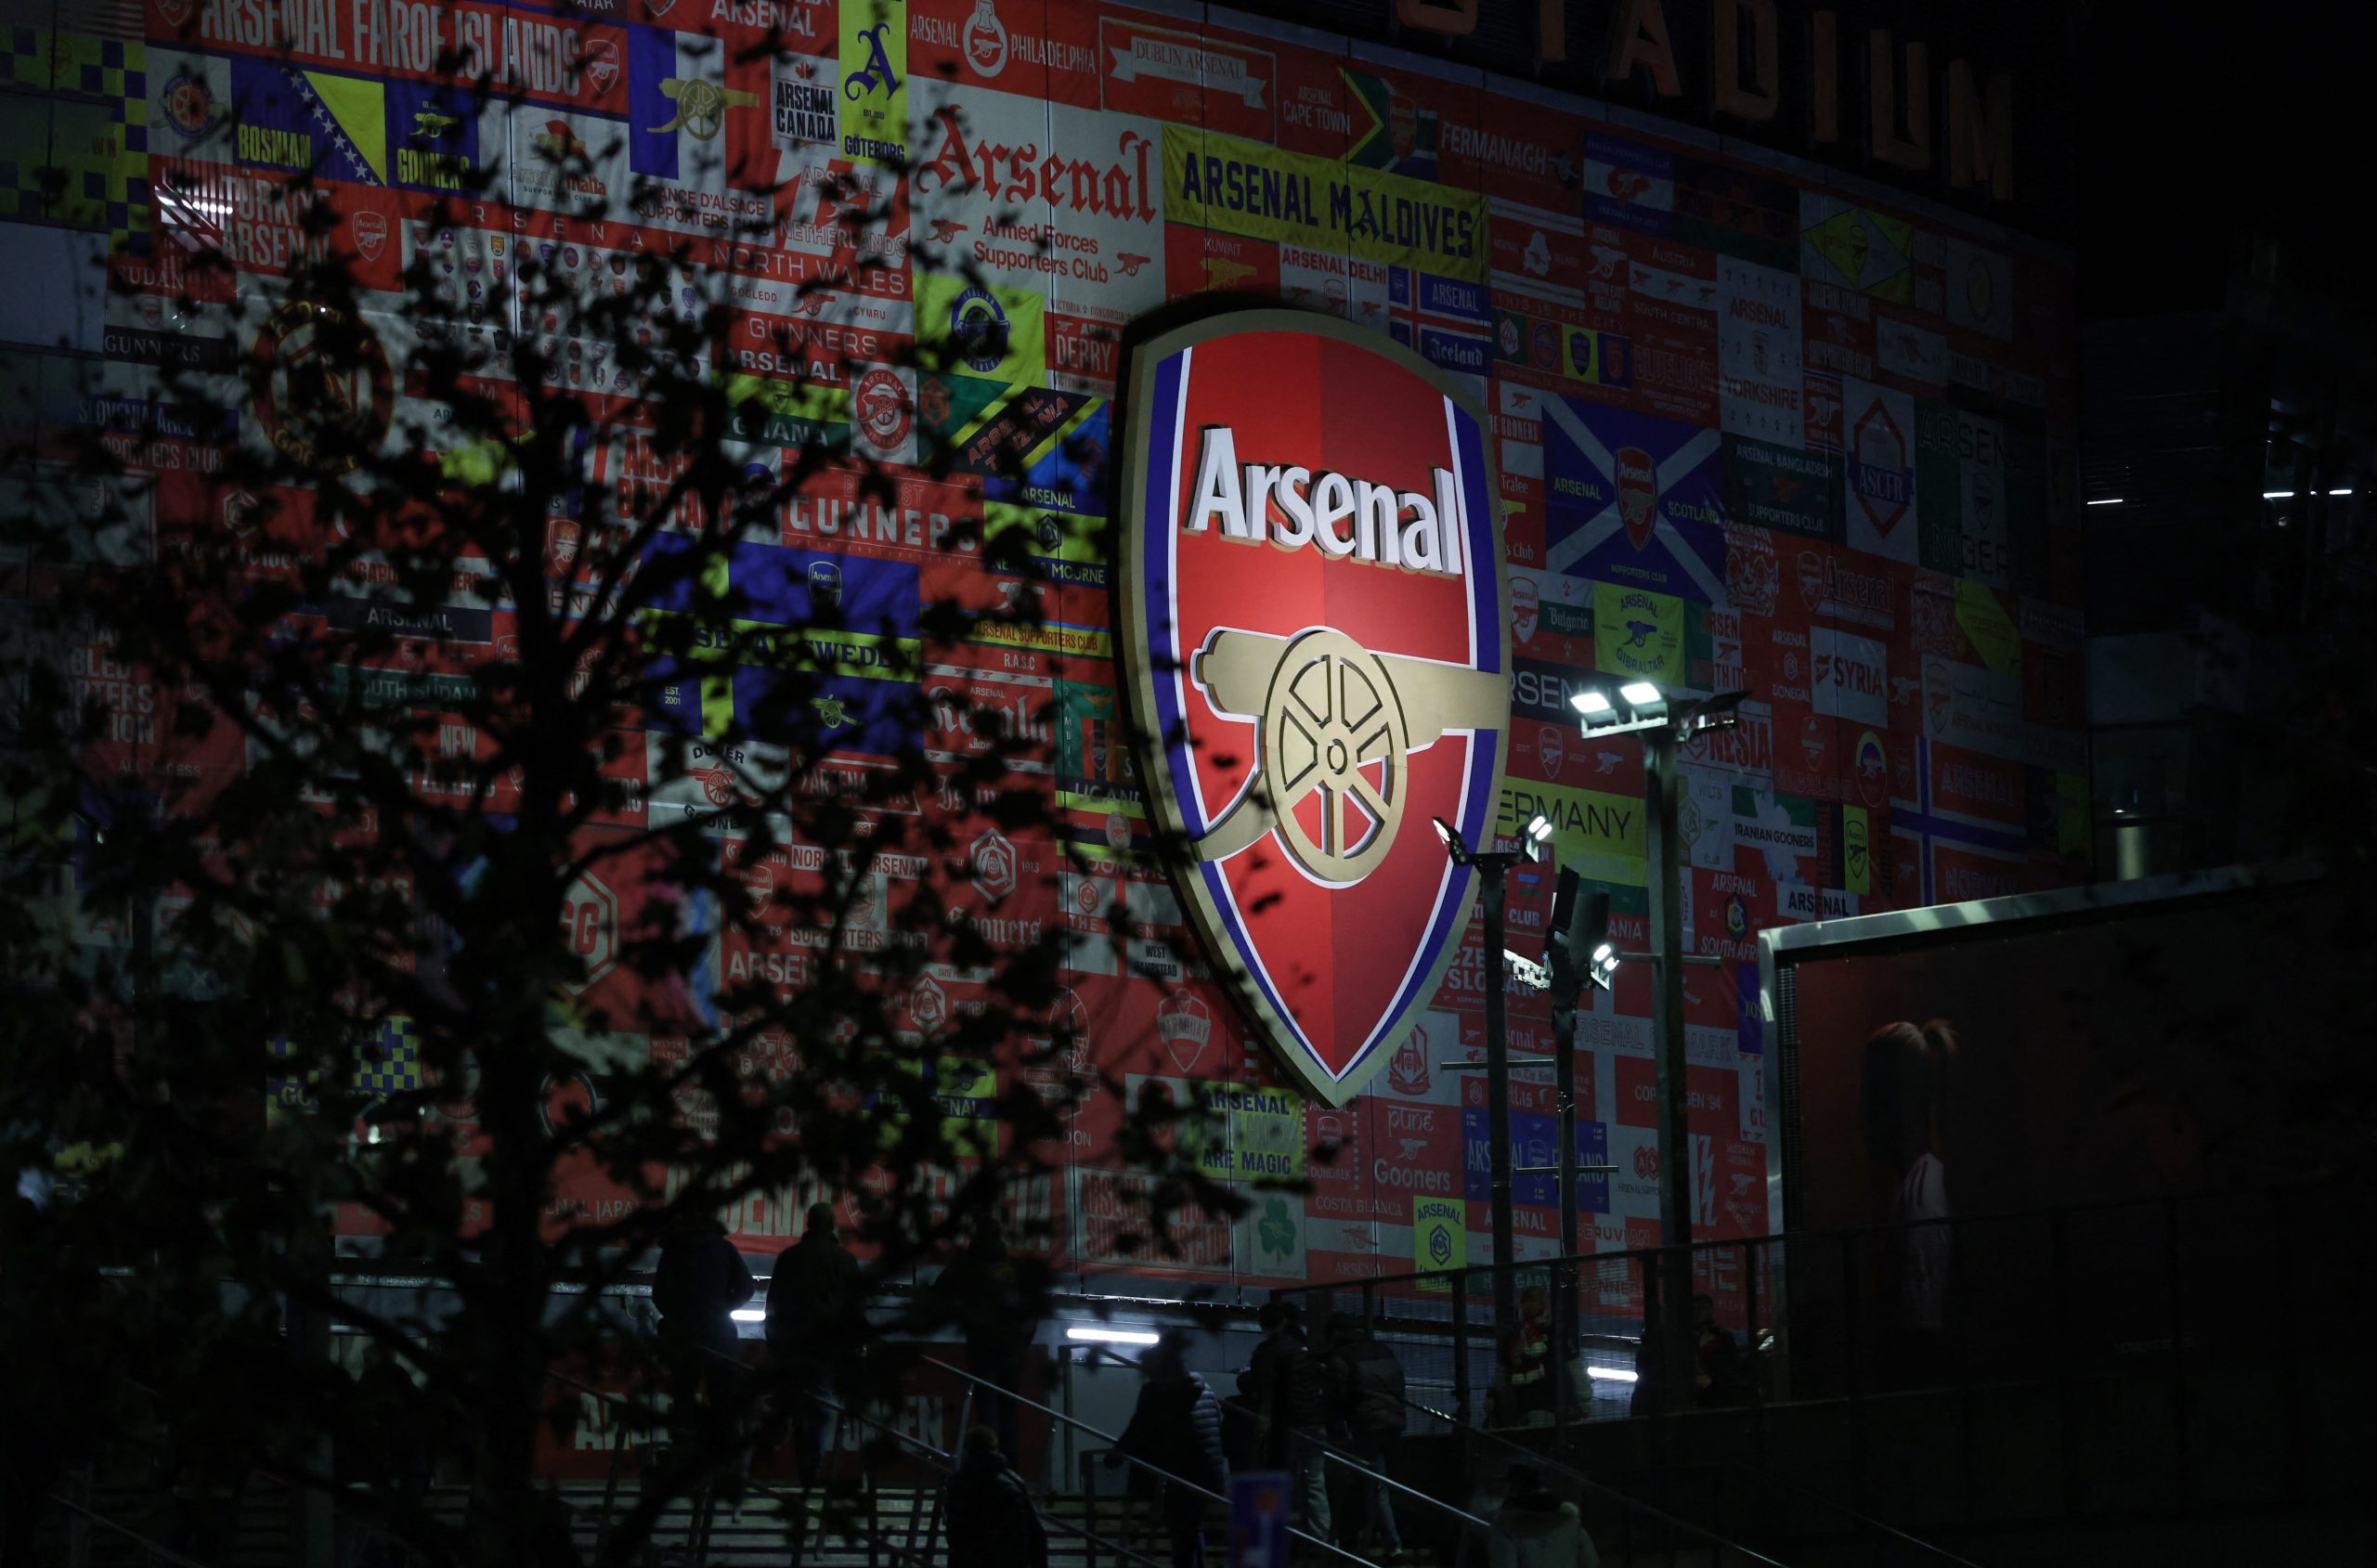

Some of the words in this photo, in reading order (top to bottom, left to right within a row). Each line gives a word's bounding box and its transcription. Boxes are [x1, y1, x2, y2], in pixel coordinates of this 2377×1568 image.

[455, 8, 580, 97] ISLANDS
[911, 15, 960, 48] ARSENAL
[1011, 33, 1097, 74] PHILADELPHIA
[1136, 42, 1183, 68] DUBLIN
[1185, 53, 1242, 81] ARSENAL
[776, 82, 836, 115] ARSENAL
[1298, 84, 1334, 107] ARSENAL
[776, 110, 836, 140] CANADA
[1283, 100, 1313, 128] CAPE
[1317, 107, 1352, 135] TOWN
[238, 123, 311, 170] BOSNIAN
[844, 136, 905, 162] GÖTEBORG
[1440, 121, 1548, 175] FERMANAGH
[916, 104, 1157, 226] Arsenal
[700, 193, 765, 215] D'ALSACE
[1183, 152, 1319, 227] ARSENAL
[1330, 181, 1474, 258] MALDIVES
[983, 215, 1038, 242] Armed
[1040, 225, 1098, 256] Forces
[1204, 238, 1241, 257] KUWAIT
[713, 247, 804, 279] NORTH
[816, 259, 905, 294] WALES
[974, 241, 1068, 276] Supporters
[1072, 257, 1109, 284] Club
[1282, 249, 1346, 276] ARSENAL
[1349, 262, 1387, 286] DELHI
[1432, 282, 1480, 313] ARSENAL
[854, 306, 886, 320] CYMRU
[1730, 298, 1790, 330] ARSENAL
[1429, 337, 1484, 366] Iceland
[1724, 375, 1799, 410] YORKSHIRE
[1501, 416, 1539, 441] GOONERS
[1736, 444, 1774, 465] ARSENAL
[1501, 474, 1529, 496] Tralee
[1619, 461, 1653, 484] Arsenal
[1021, 486, 1076, 510] ARSENAL
[1188, 425, 1463, 575] Arsenal
[1553, 476, 1603, 500] ARSENAL
[1667, 500, 1720, 525] SCOTLAND
[1747, 502, 1800, 528] SUPPORTERS
[1513, 542, 1534, 561] Club
[1611, 564, 1650, 581] SUPPORTERS
[1823, 554, 1895, 614] Arsenal
[1548, 606, 1589, 631] Bulgaria
[1618, 593, 1659, 618] ARSENAL
[979, 623, 1018, 642] ARSENAL
[1020, 627, 1075, 649] SUPPORTERS
[1077, 636, 1098, 651] CLUB
[1772, 628, 1808, 647] ARSENAL
[1004, 654, 1035, 670] R.A.S.C
[1616, 648, 1666, 675] GIBRALTAR
[1834, 657, 1884, 696] SYRIA
[665, 685, 682, 695] EST.
[665, 695, 682, 706] 2001
[969, 687, 1006, 700] ARSENAL
[1734, 823, 1773, 841] IRANIAN
[1773, 833, 1814, 849] GOONERS
[1021, 862, 1041, 875] 1913
[1711, 874, 1759, 897] ARSENAL
[1788, 891, 1851, 917] ARSENAL
[1508, 908, 1541, 927] CLUB
[1145, 945, 1166, 958] WEST
[1701, 936, 1736, 957] SOUTH
[1203, 1090, 1291, 1115] ARSENAL
[1202, 1148, 1235, 1168] ARE
[1241, 1152, 1292, 1175] MAGIC
[1374, 1158, 1452, 1193] Gooners
[1315, 1195, 1354, 1212] COSTA
[1357, 1199, 1404, 1218] BLANCA
[1417, 1203, 1461, 1226] ARSENAL
